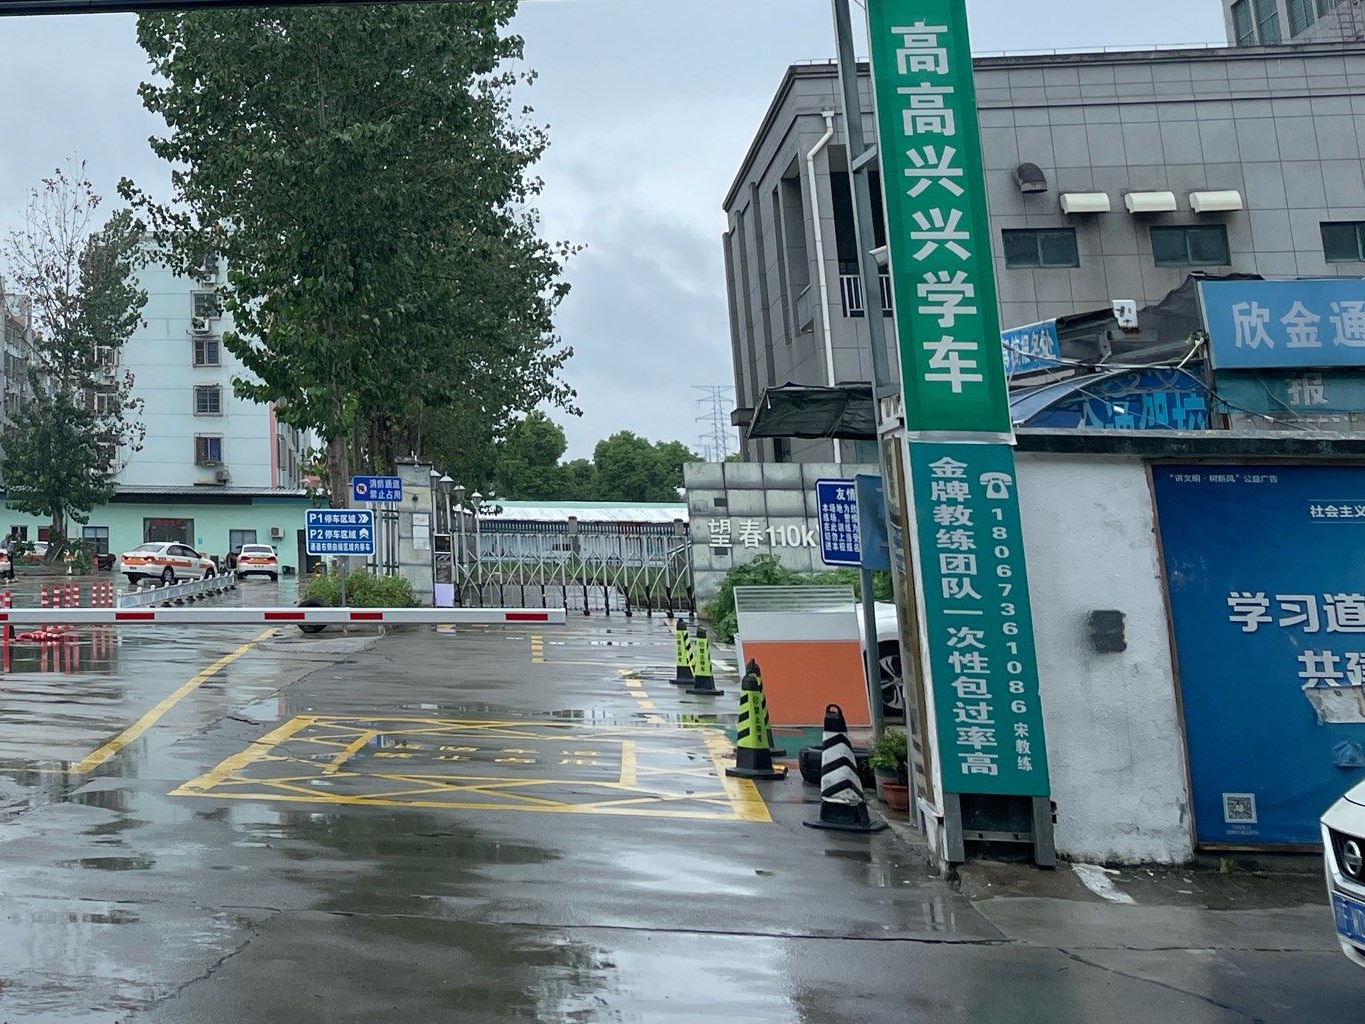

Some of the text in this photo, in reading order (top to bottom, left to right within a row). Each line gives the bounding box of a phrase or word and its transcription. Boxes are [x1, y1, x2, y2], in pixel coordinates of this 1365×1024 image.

[890, 20, 984, 394] 高高兴兴学车
[1232, 300, 1365, 351] 欣金通
[1309, 504, 1365, 519] 社会主义
[927, 456, 999, 777] 金牌教练团队一次性包过率高
[1227, 592, 1365, 634] 学习道
